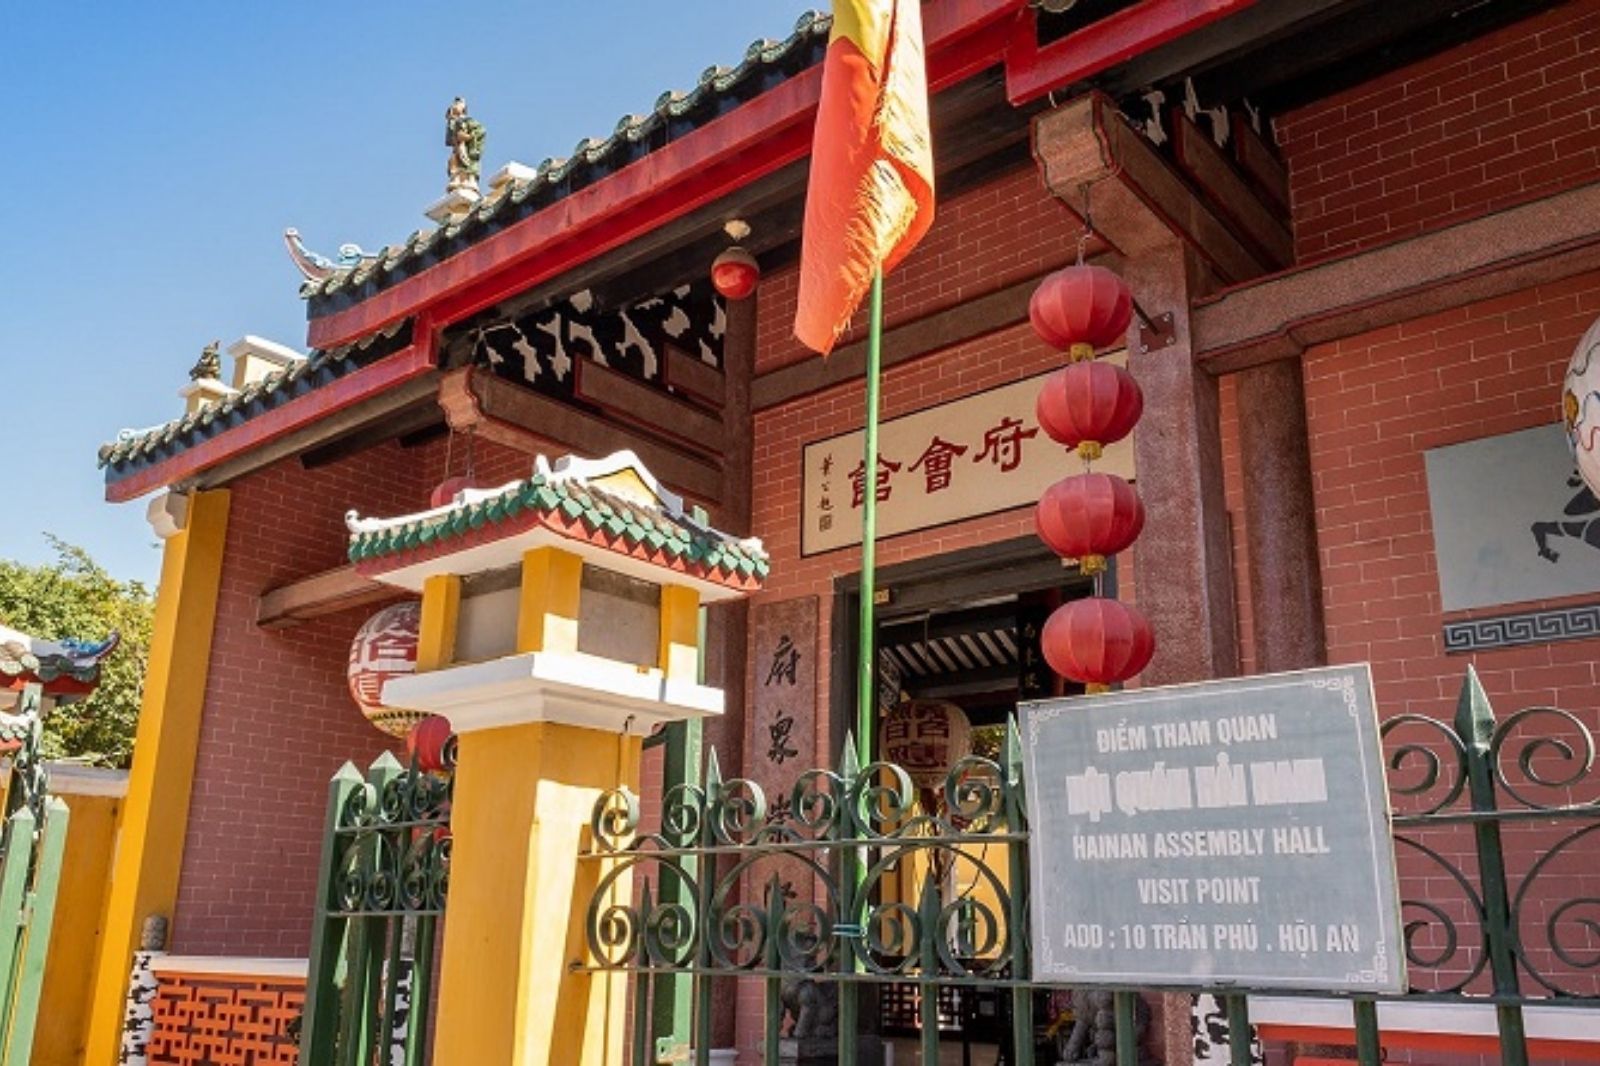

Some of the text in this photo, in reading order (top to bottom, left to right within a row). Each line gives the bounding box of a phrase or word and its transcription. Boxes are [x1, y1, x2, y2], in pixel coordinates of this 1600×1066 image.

[1097, 713, 1277, 753] ĐIỂM THAM QUAN
[1073, 826, 1330, 860] HAINAN ASSEMBLY HALL
[1137, 876, 1260, 904] VISIT POINT
[1063, 924, 1102, 949] ADD
[1121, 924, 1146, 949] 10
[1279, 919, 1318, 958] HỘI
[1326, 924, 1360, 952] AN
